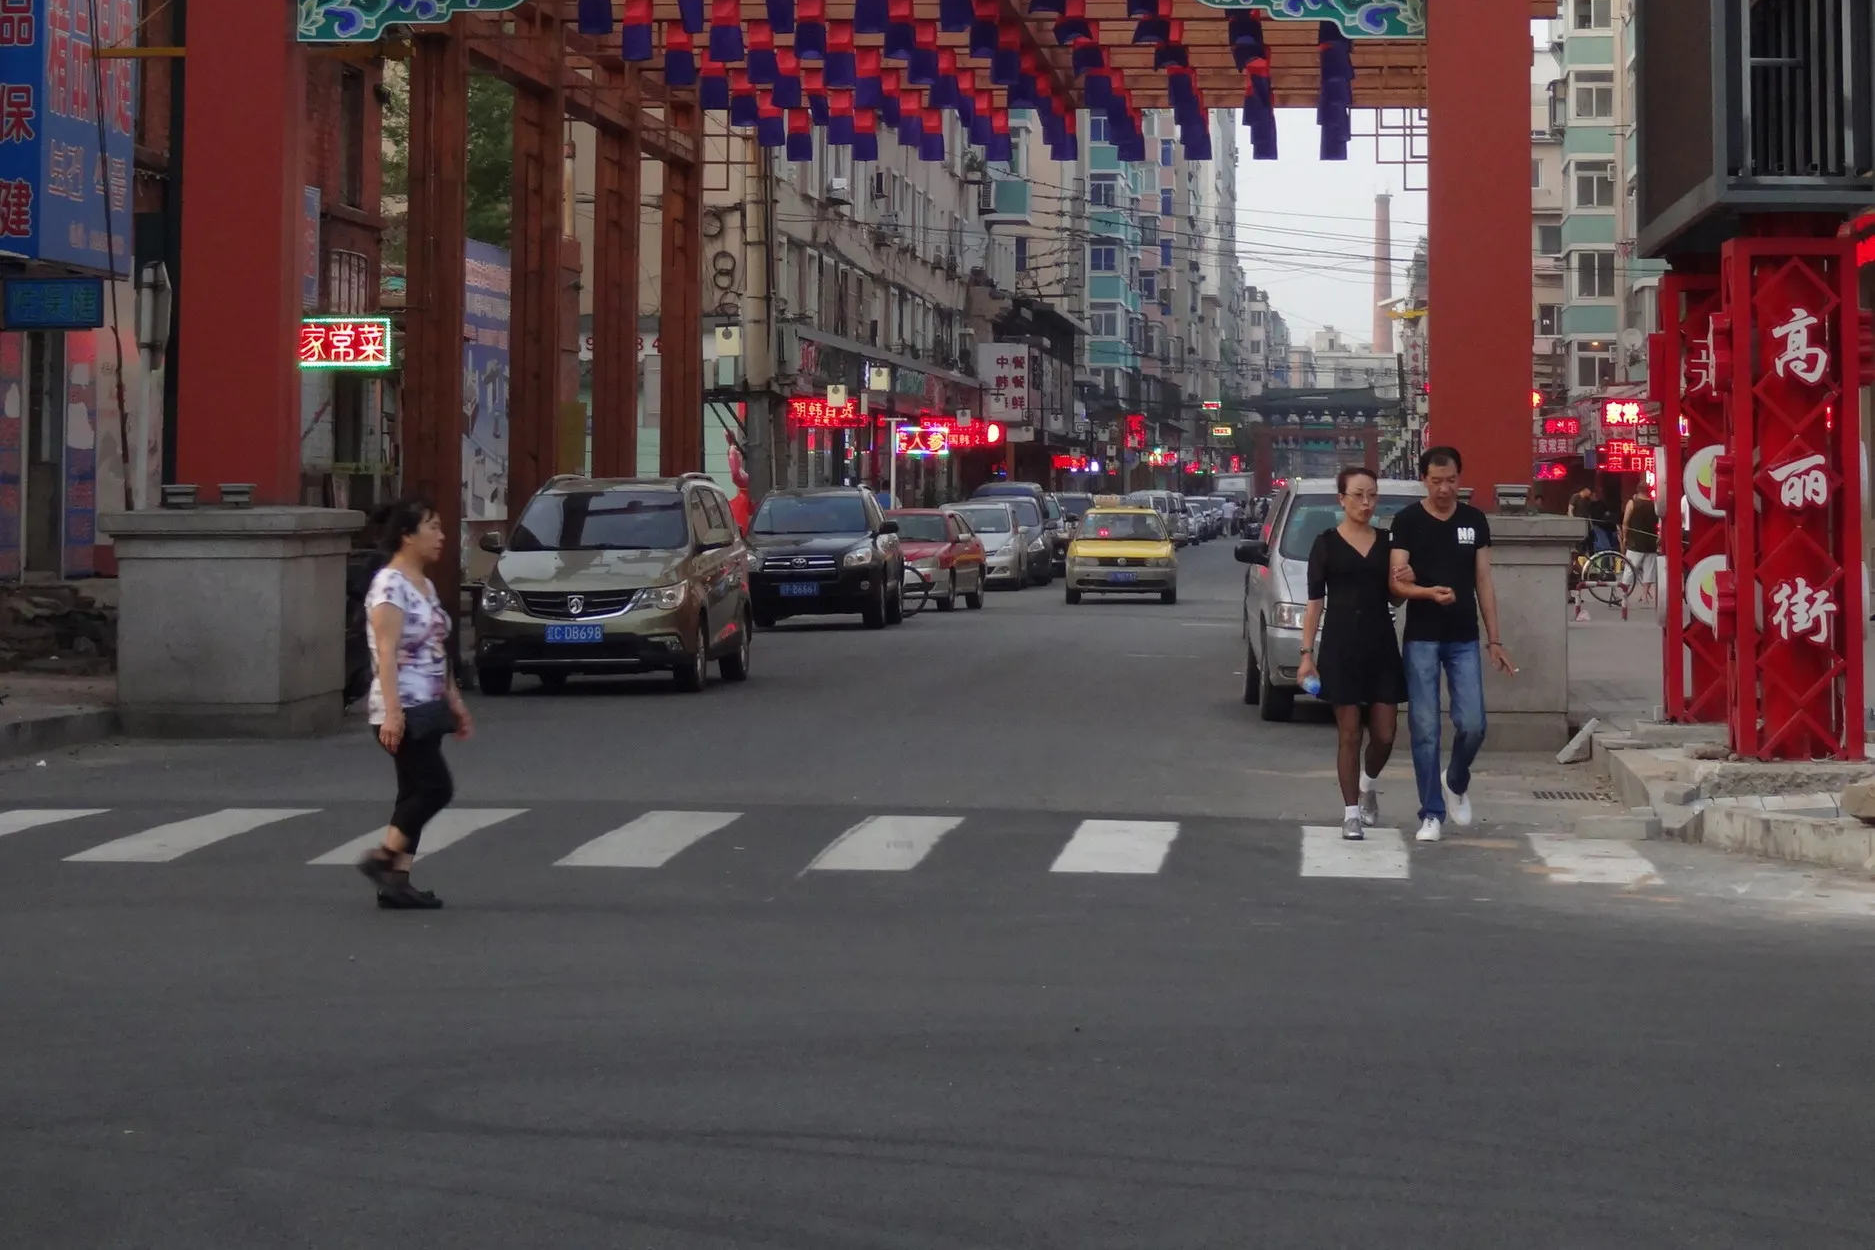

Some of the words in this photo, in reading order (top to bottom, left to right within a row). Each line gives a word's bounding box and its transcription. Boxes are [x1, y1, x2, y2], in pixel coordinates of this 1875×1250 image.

[301, 324, 385, 362] 家常菜
[1768, 308, 1837, 643] 高丽街
